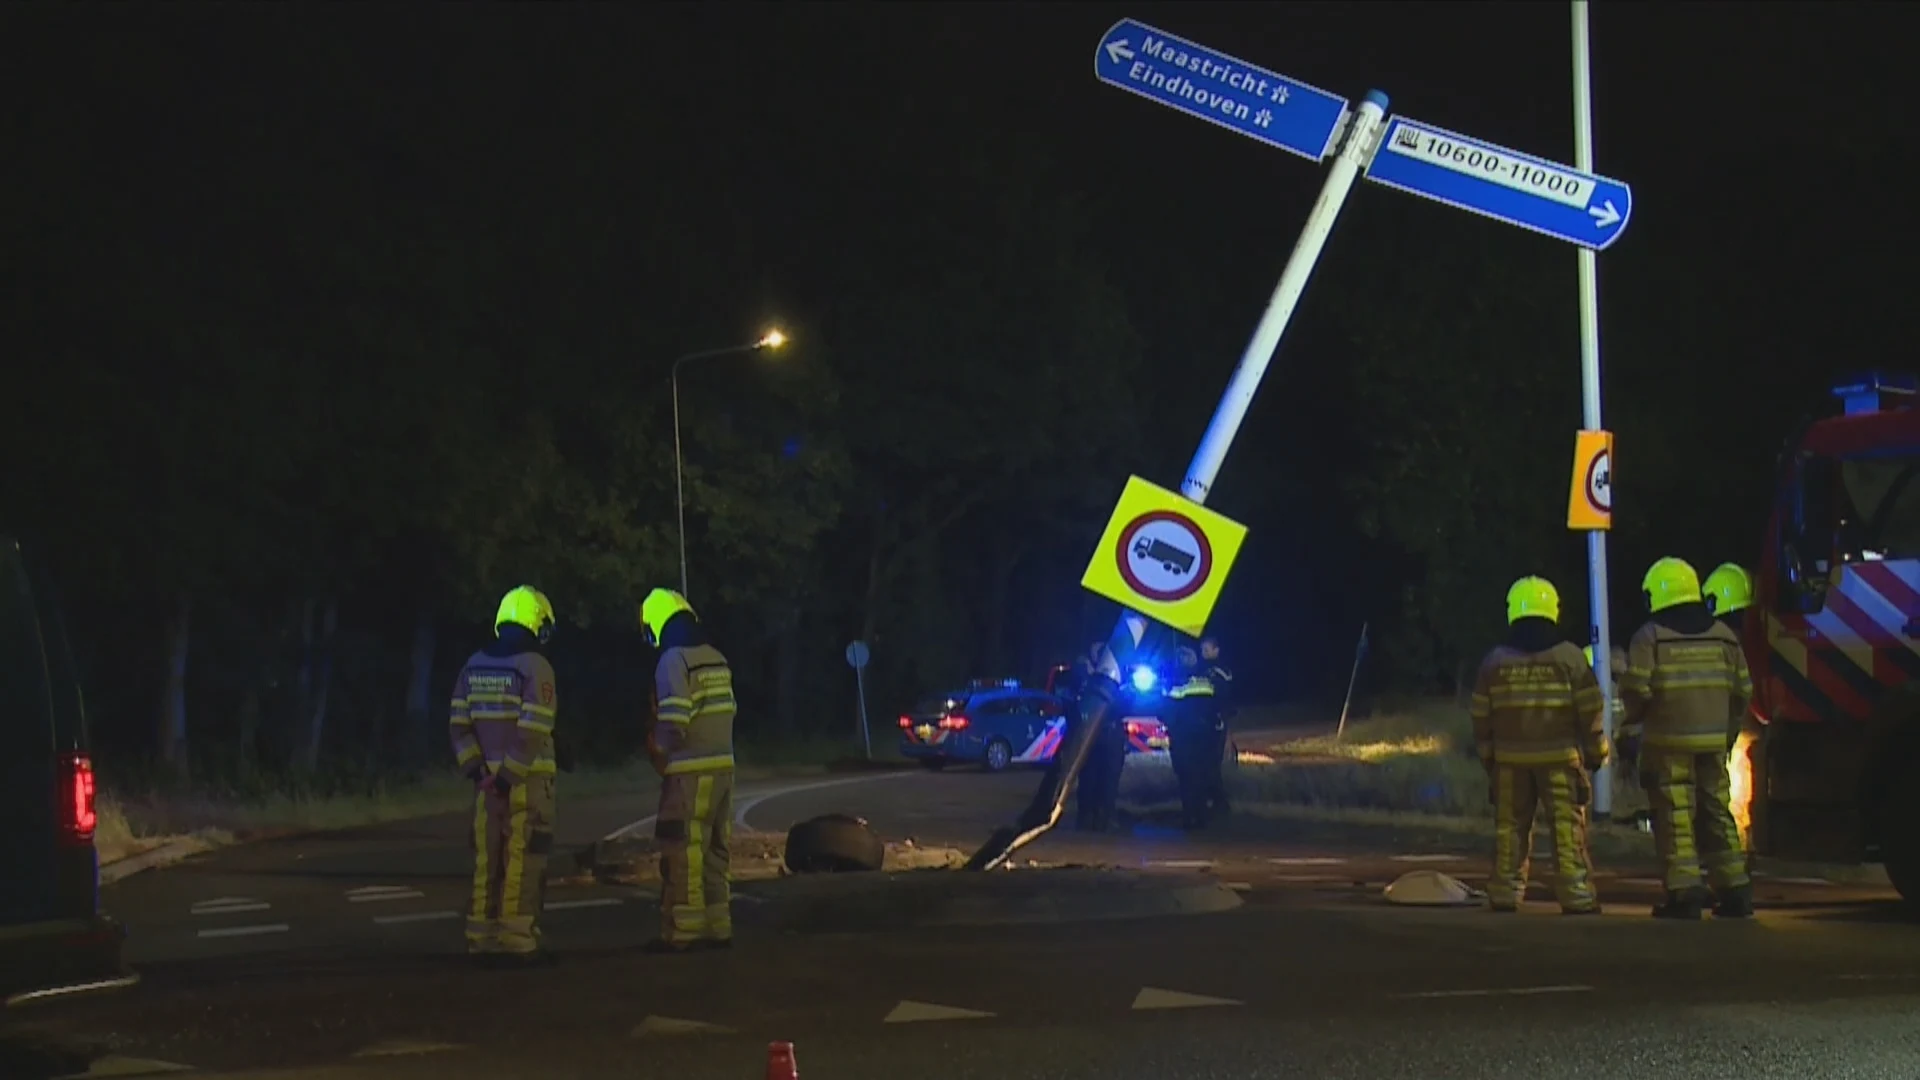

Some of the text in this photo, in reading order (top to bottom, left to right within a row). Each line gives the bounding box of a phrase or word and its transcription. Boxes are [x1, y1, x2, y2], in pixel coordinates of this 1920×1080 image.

[1129, 61, 1249, 121] Eindhoven
[1141, 35, 1269, 97] Maastricht
[1427, 138, 1580, 197] 10600-11000
